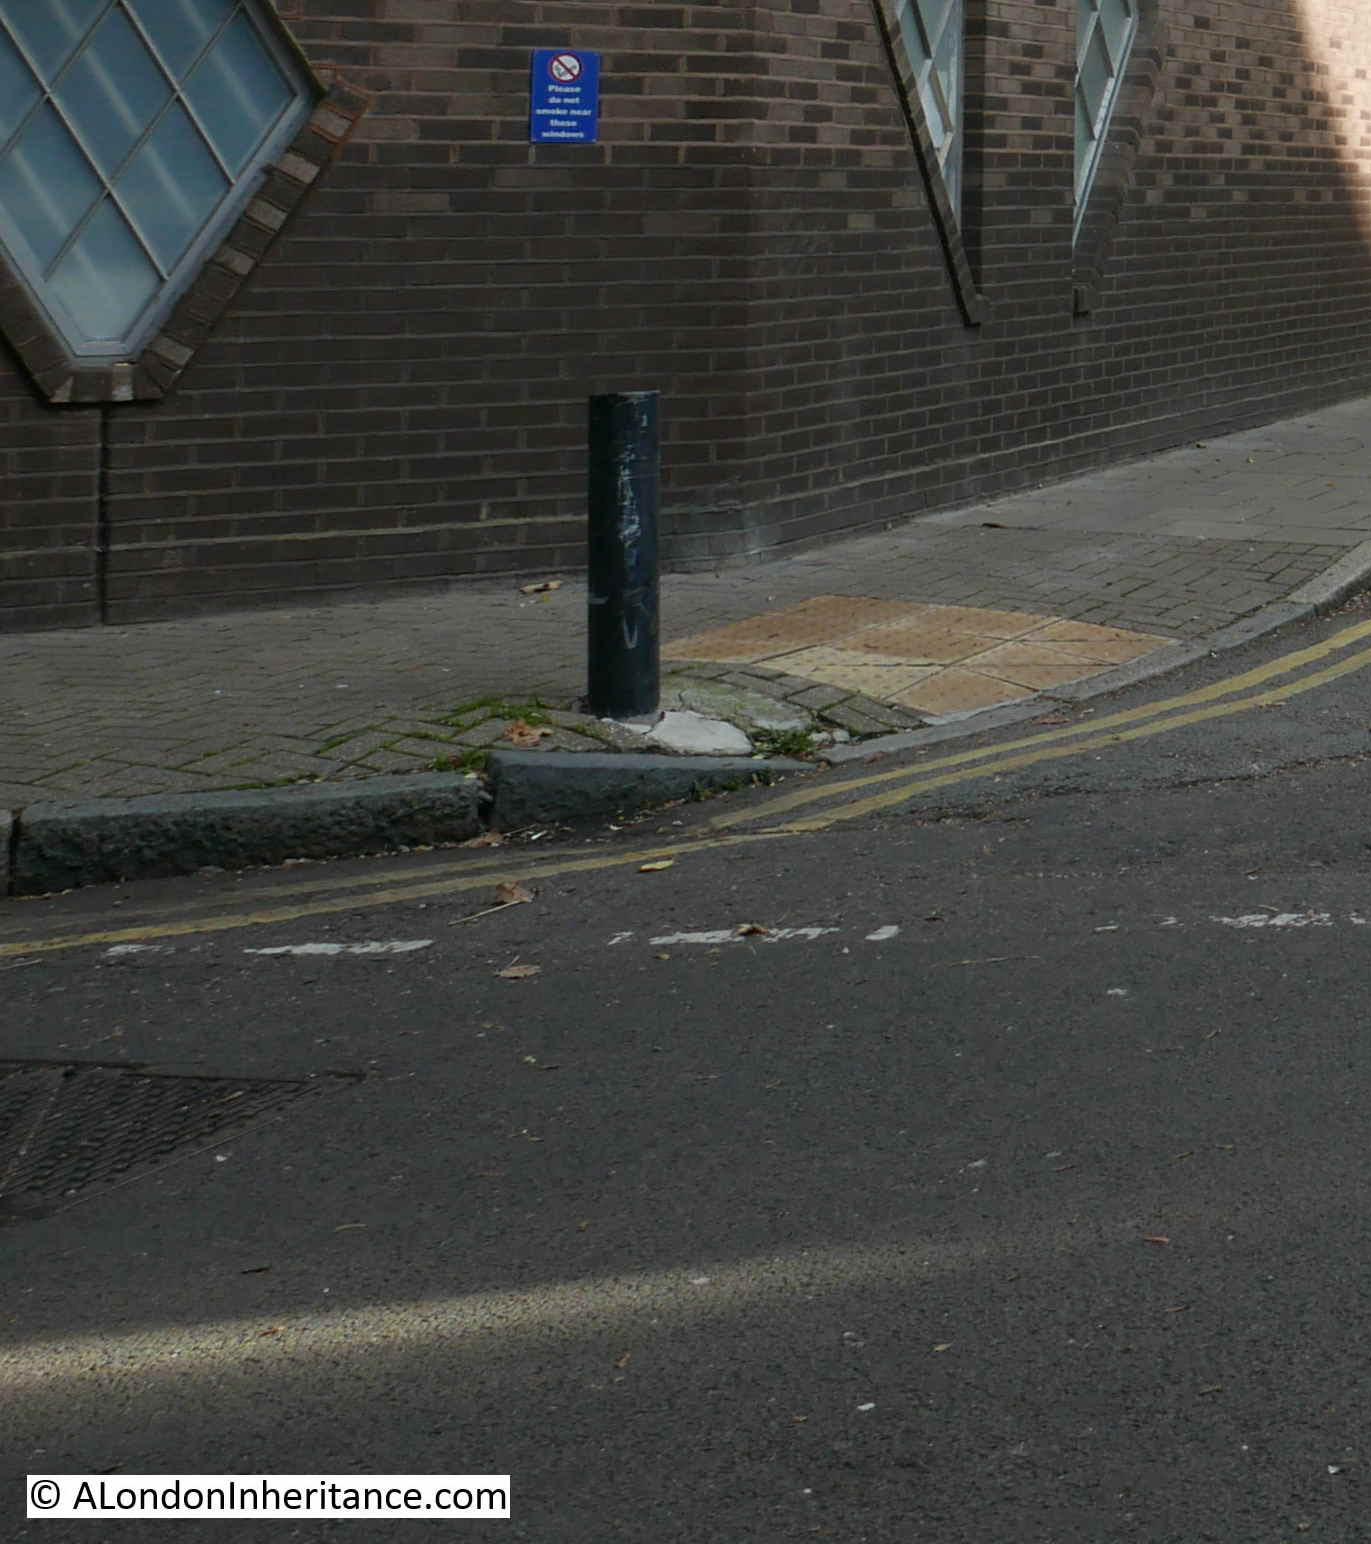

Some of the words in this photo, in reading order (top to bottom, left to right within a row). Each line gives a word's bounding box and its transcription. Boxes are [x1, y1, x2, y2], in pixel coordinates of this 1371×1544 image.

[548, 85, 582, 93] Please
[548, 96, 561, 104] do
[536, 107, 569, 115] smoke
[550, 119, 577, 127] these
[541, 130, 584, 138] windows
